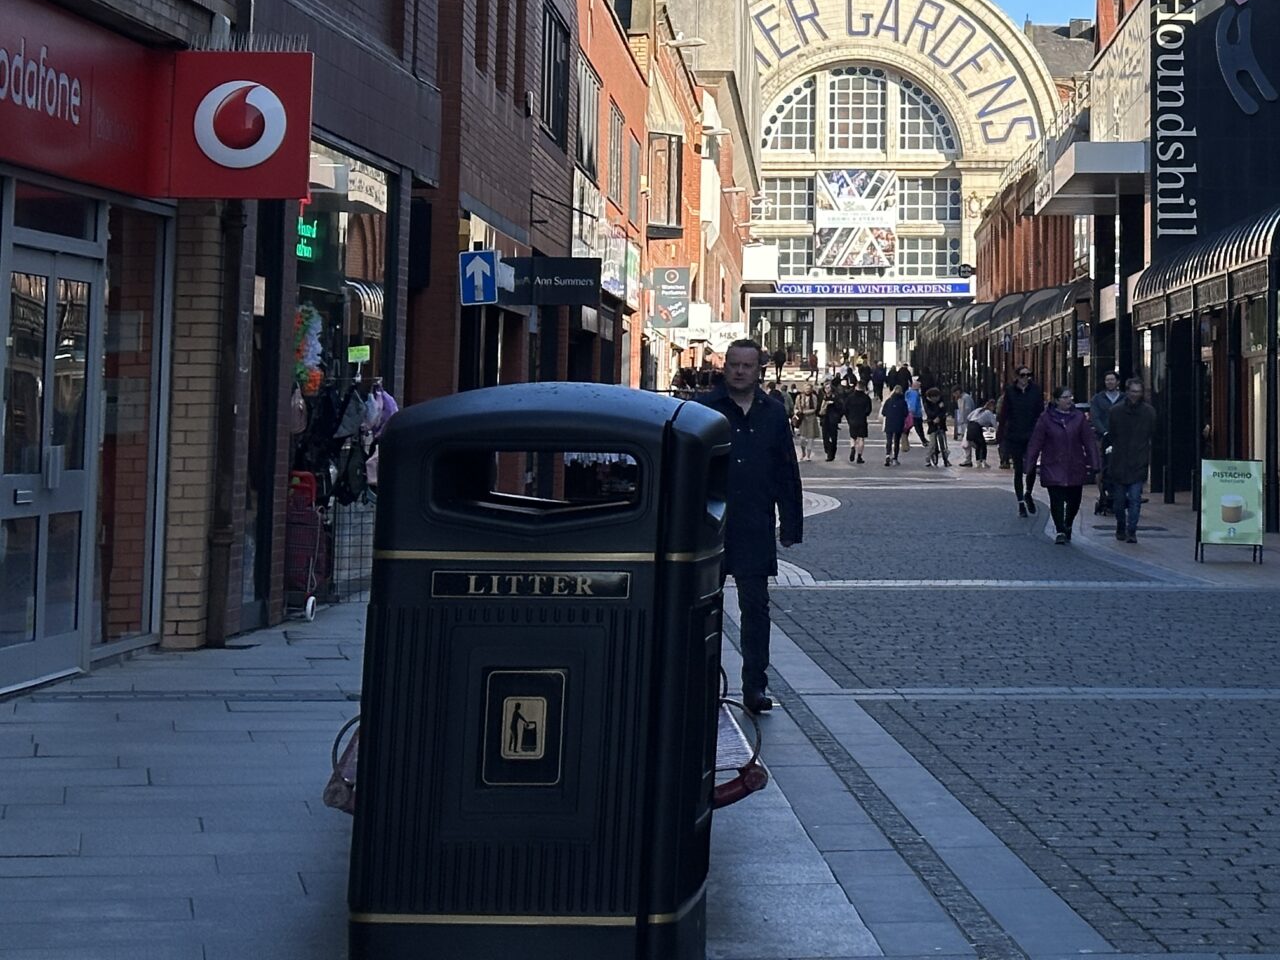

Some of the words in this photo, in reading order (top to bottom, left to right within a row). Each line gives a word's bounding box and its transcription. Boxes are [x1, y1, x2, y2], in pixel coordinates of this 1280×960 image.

[0, 37, 82, 125] odafone
[534, 276, 552, 286] Ann
[553, 276, 594, 287] Summers
[780, 284, 813, 295] COME
[814, 284, 830, 294] TO
[831, 284, 854, 294] THE
[857, 284, 900, 294] WINTER
[901, 284, 952, 294] GARDENS
[719, 331, 738, 340] M&S
[1212, 471, 1253, 480] PISTACHIO
[467, 574, 595, 596] LITTER
